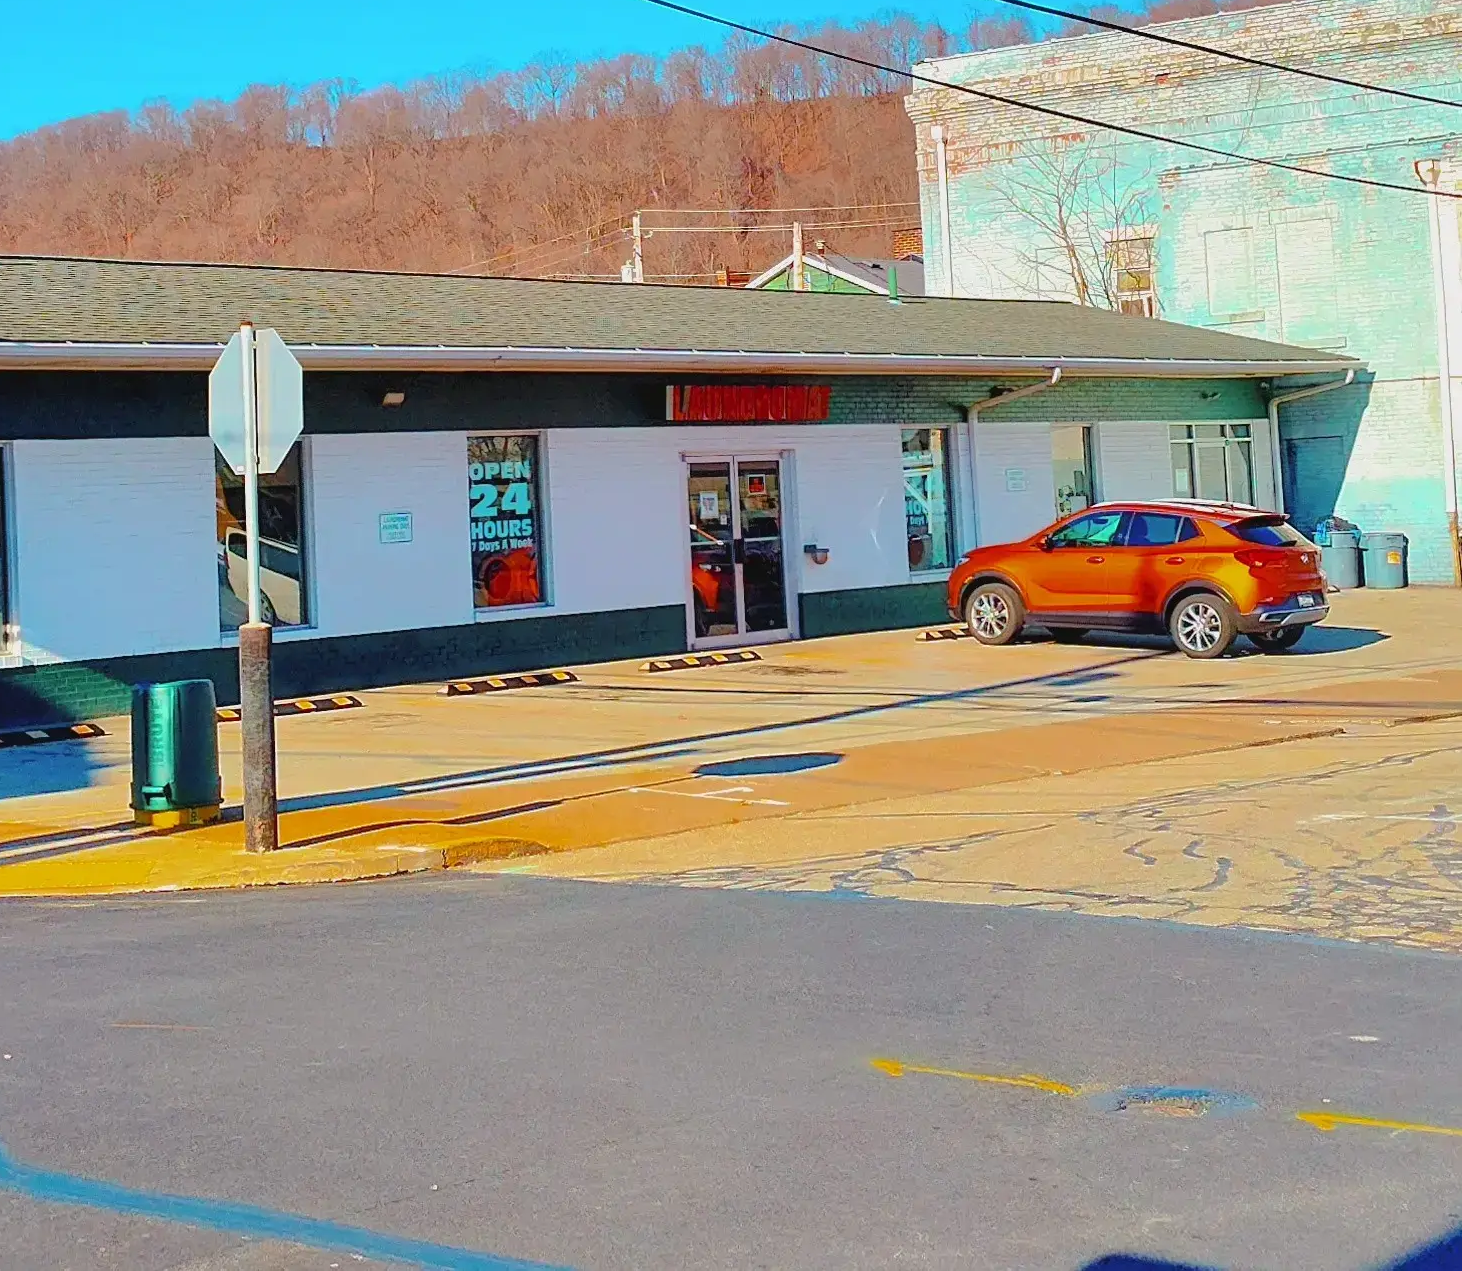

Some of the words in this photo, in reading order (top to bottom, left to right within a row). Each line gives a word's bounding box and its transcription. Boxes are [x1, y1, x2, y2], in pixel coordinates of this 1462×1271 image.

[469, 461, 532, 481] OPEN
[470, 482, 532, 517] 24
[471, 518, 532, 540] HOURS
[471, 541, 477, 552] 7
[478, 540, 500, 552] Days
[501, 539, 508, 550] A
[509, 537, 533, 549] Week
